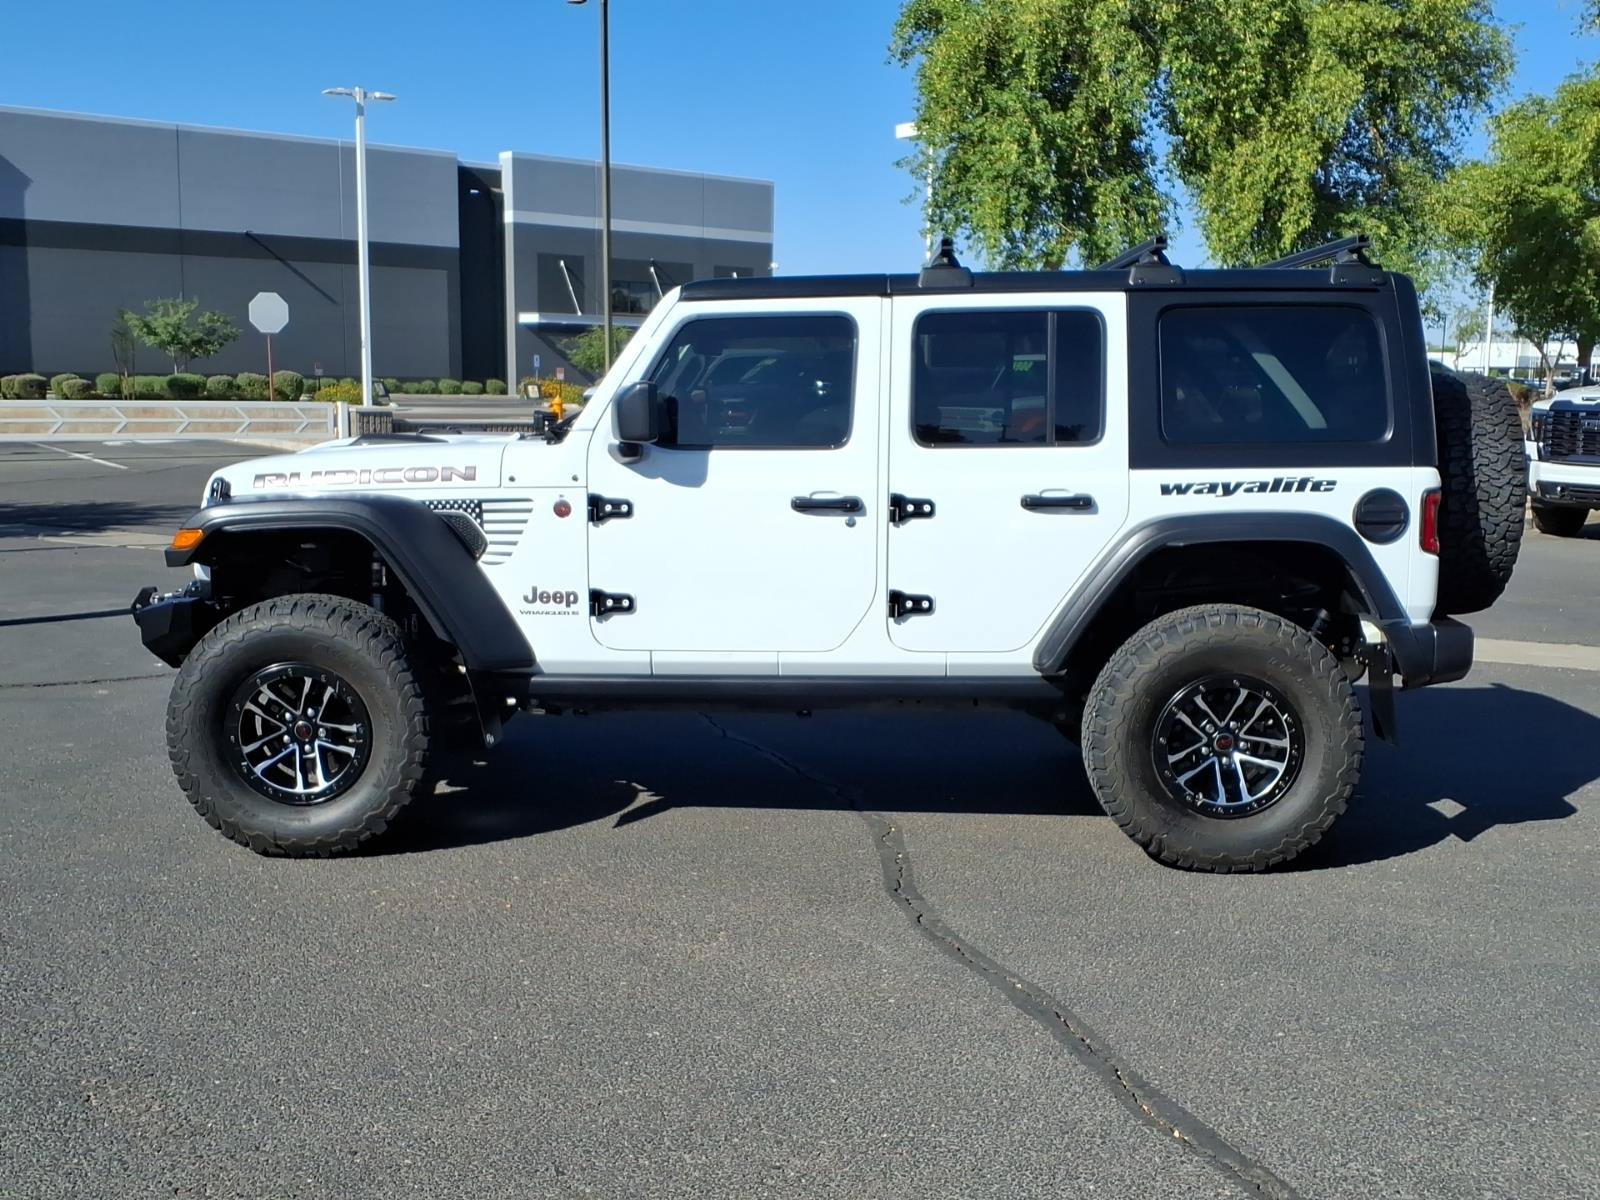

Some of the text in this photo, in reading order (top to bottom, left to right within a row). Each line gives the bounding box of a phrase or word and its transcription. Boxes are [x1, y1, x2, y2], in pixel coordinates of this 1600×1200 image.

[253, 465, 476, 488] RUBICON
[1160, 476, 1338, 497] wayalife
[523, 586, 579, 608] Jeep
